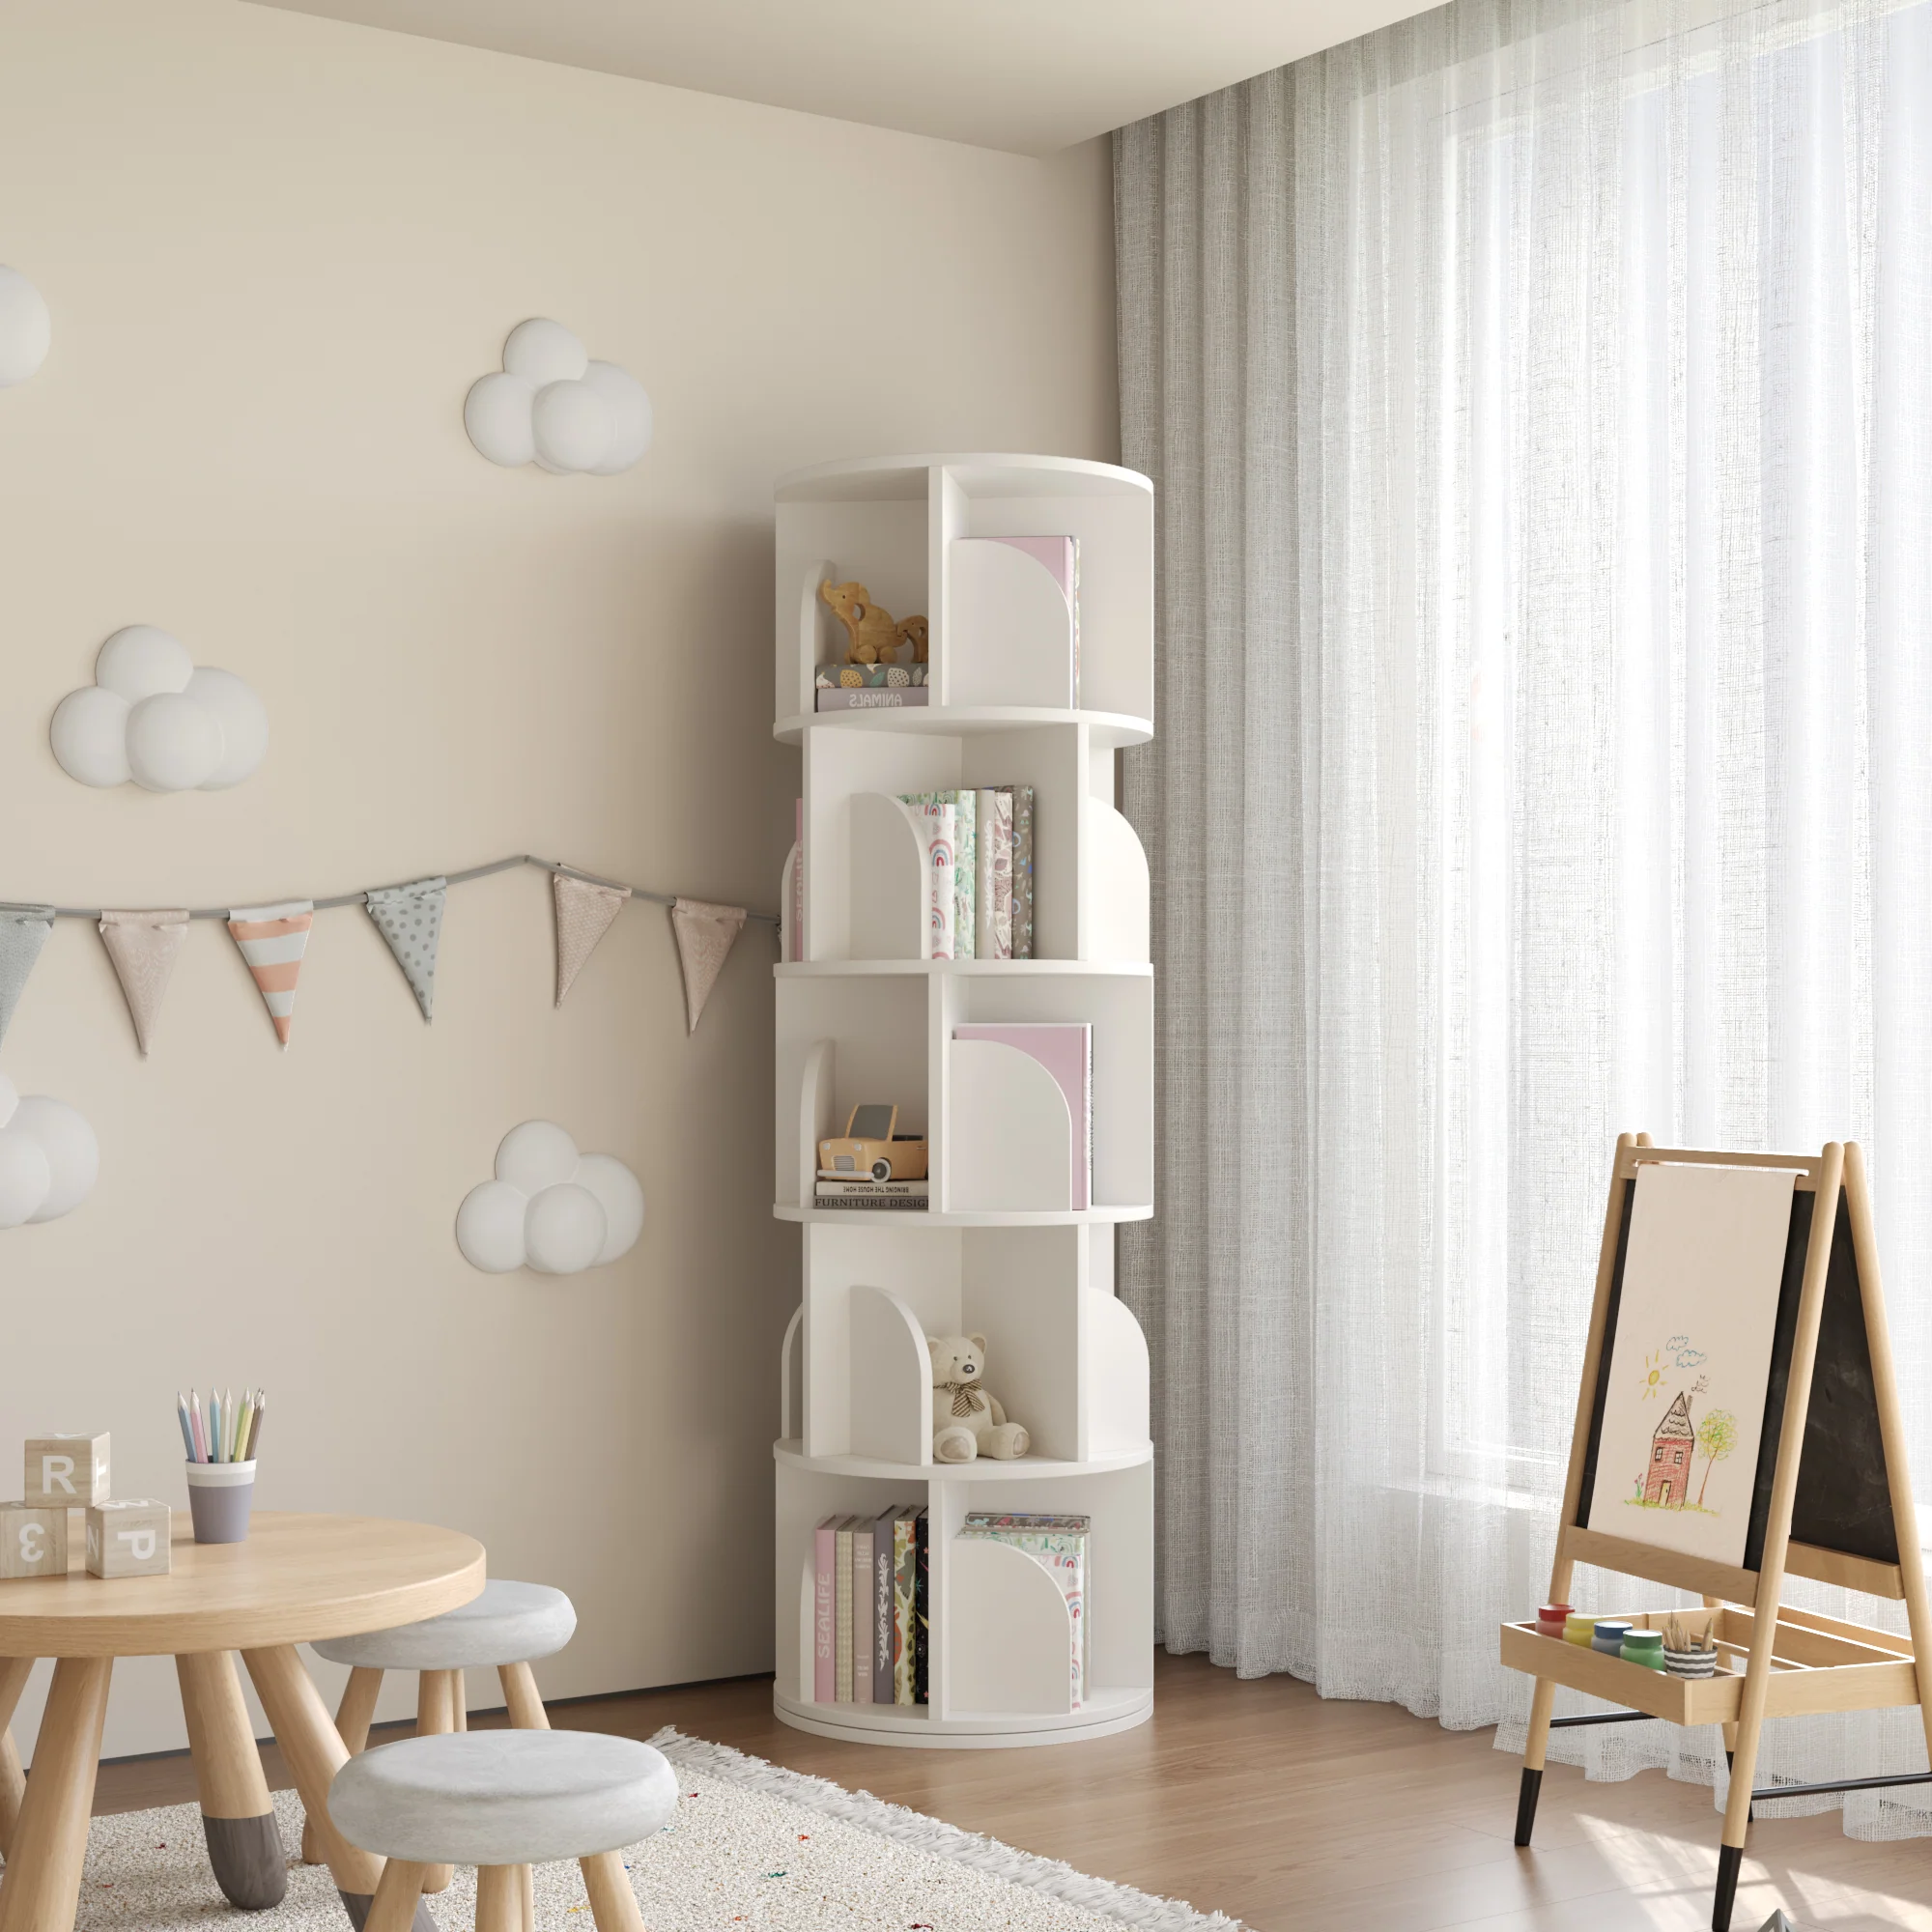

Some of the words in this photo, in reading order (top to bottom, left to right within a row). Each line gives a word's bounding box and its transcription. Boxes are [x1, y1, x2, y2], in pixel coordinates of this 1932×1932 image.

[815, 1198, 886, 1207] FURNITURE
[43, 1455, 77, 1494] R
[118, 1530, 156, 1560] P
[817, 1572, 830, 1660] SEALIFE
